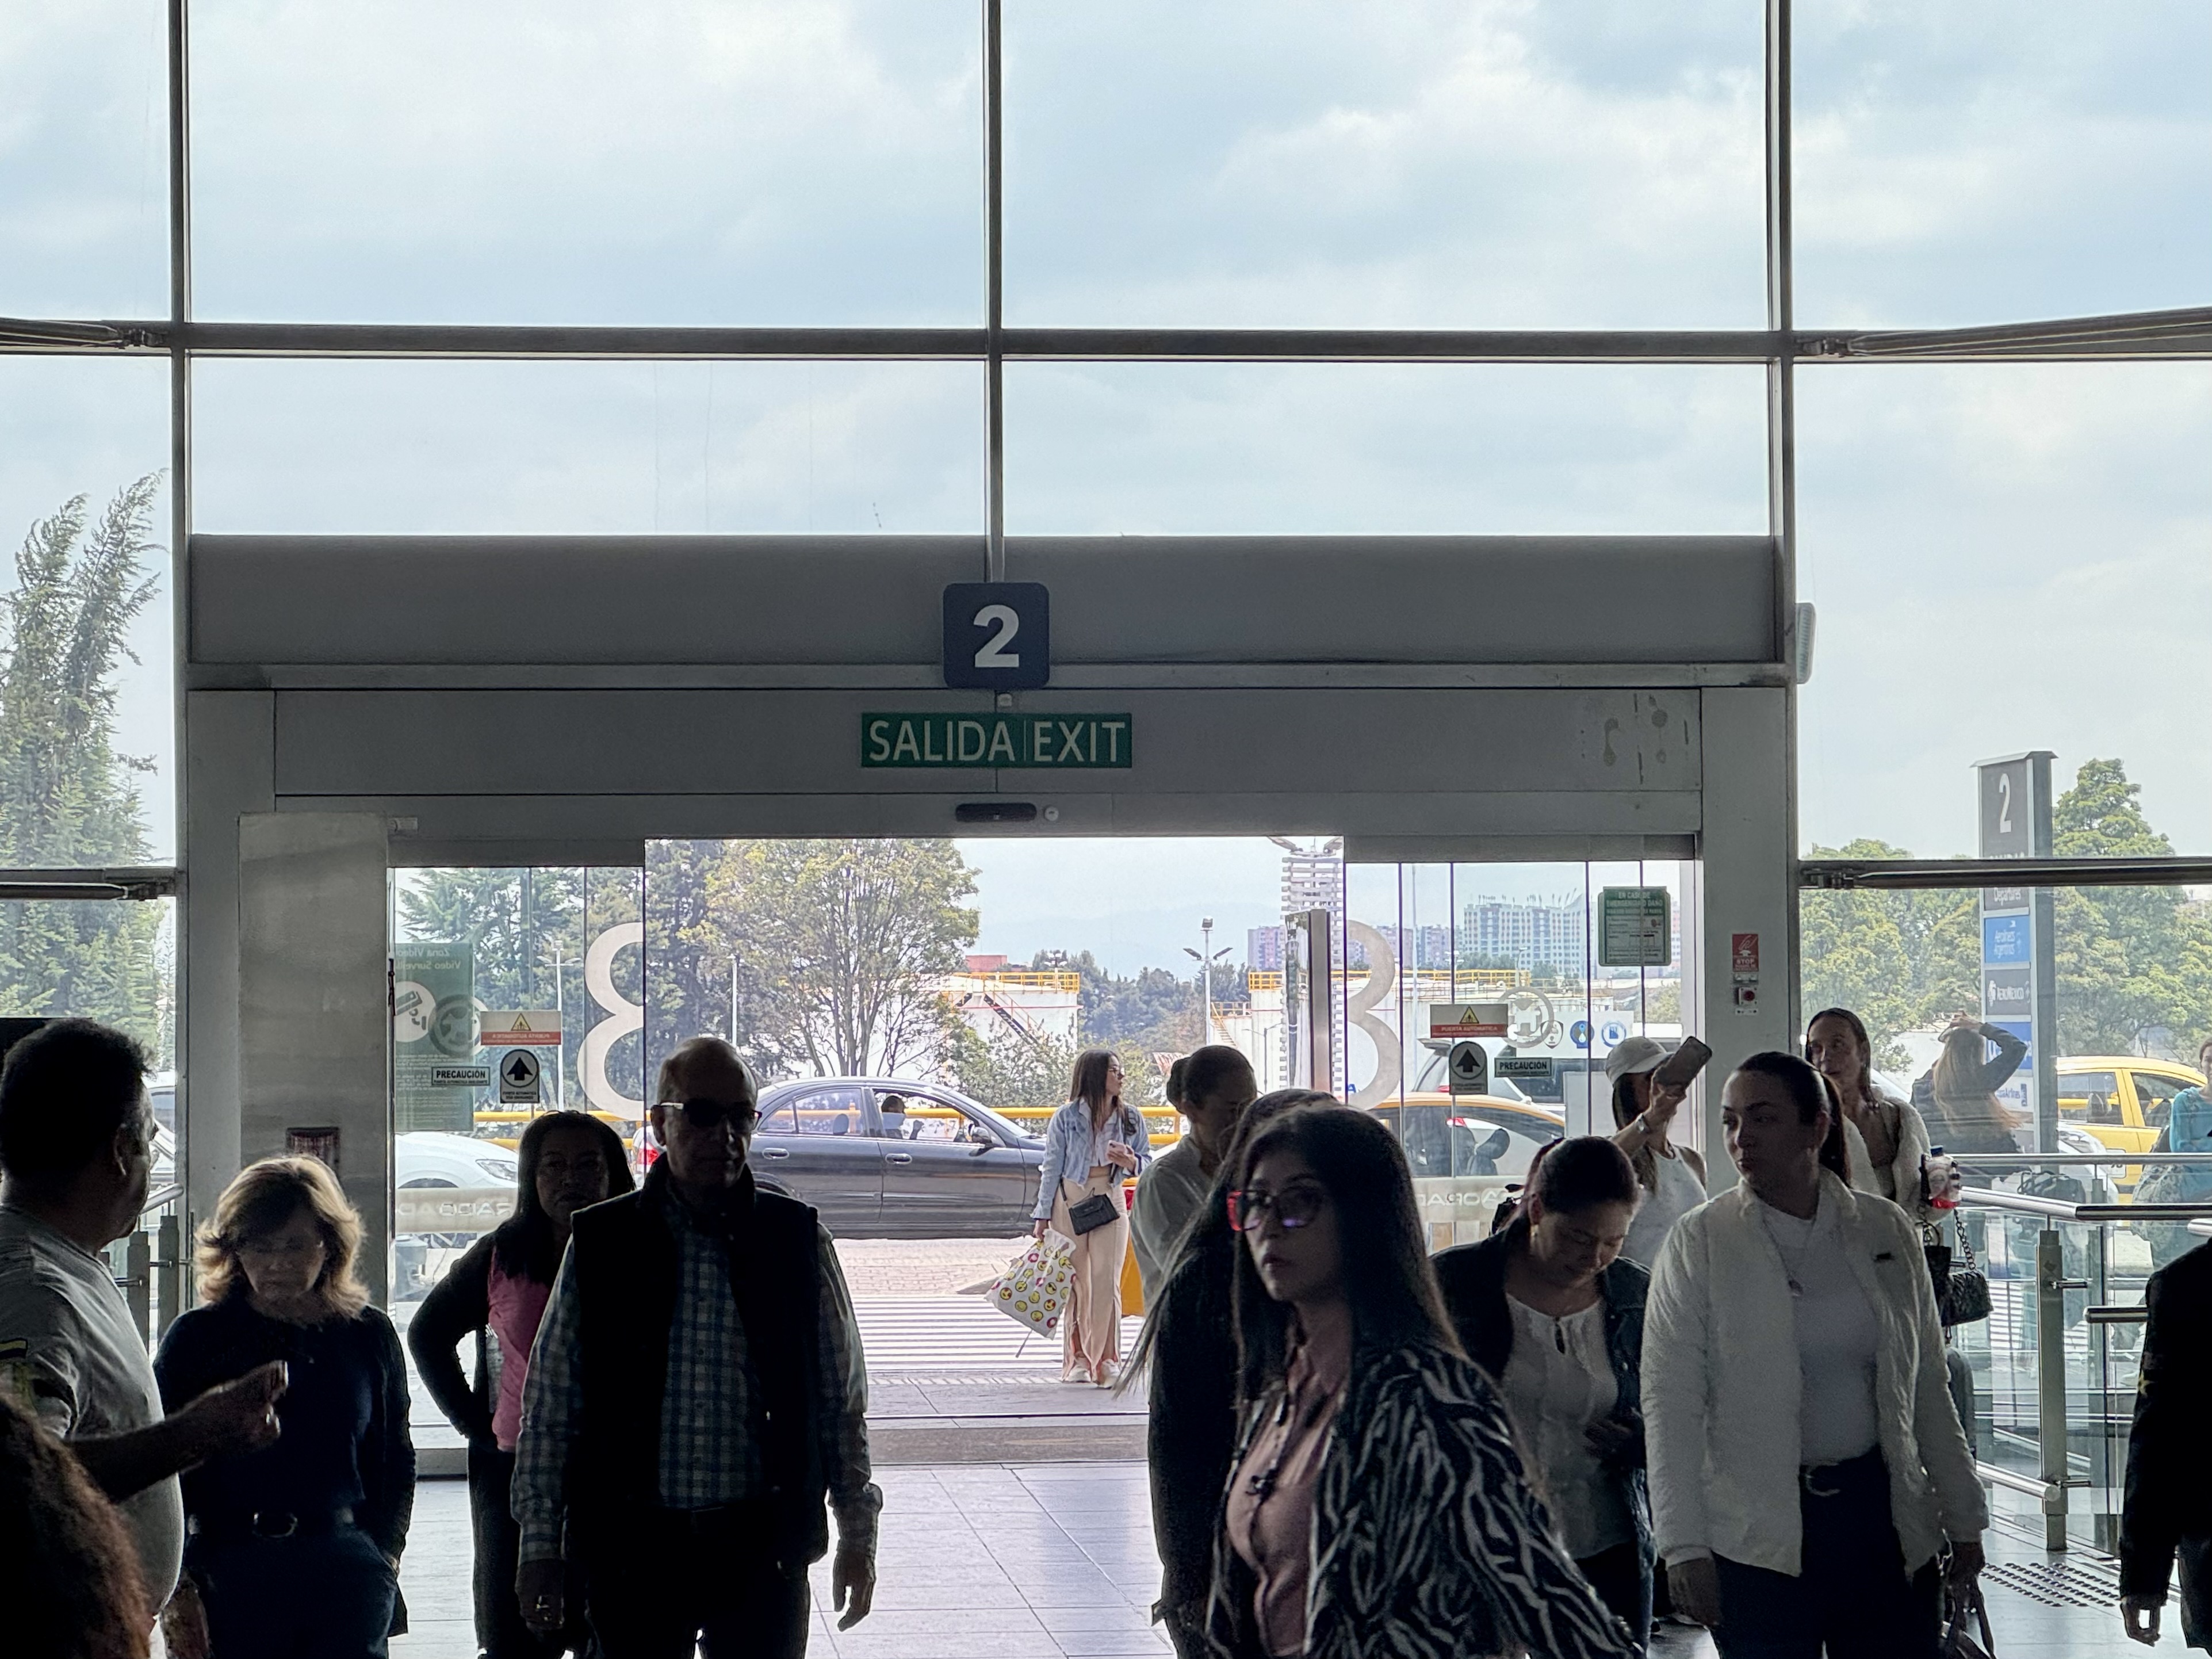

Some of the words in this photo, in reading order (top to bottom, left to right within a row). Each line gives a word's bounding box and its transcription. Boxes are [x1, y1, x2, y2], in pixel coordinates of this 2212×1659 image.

[973, 604, 1019, 668] 2
[869, 720, 1015, 762] SALIDA
[1034, 721, 1126, 763] EXIT
[1999, 773, 2012, 833] 2
[1499, 1060, 1547, 1071] PRECAUCIÓN
